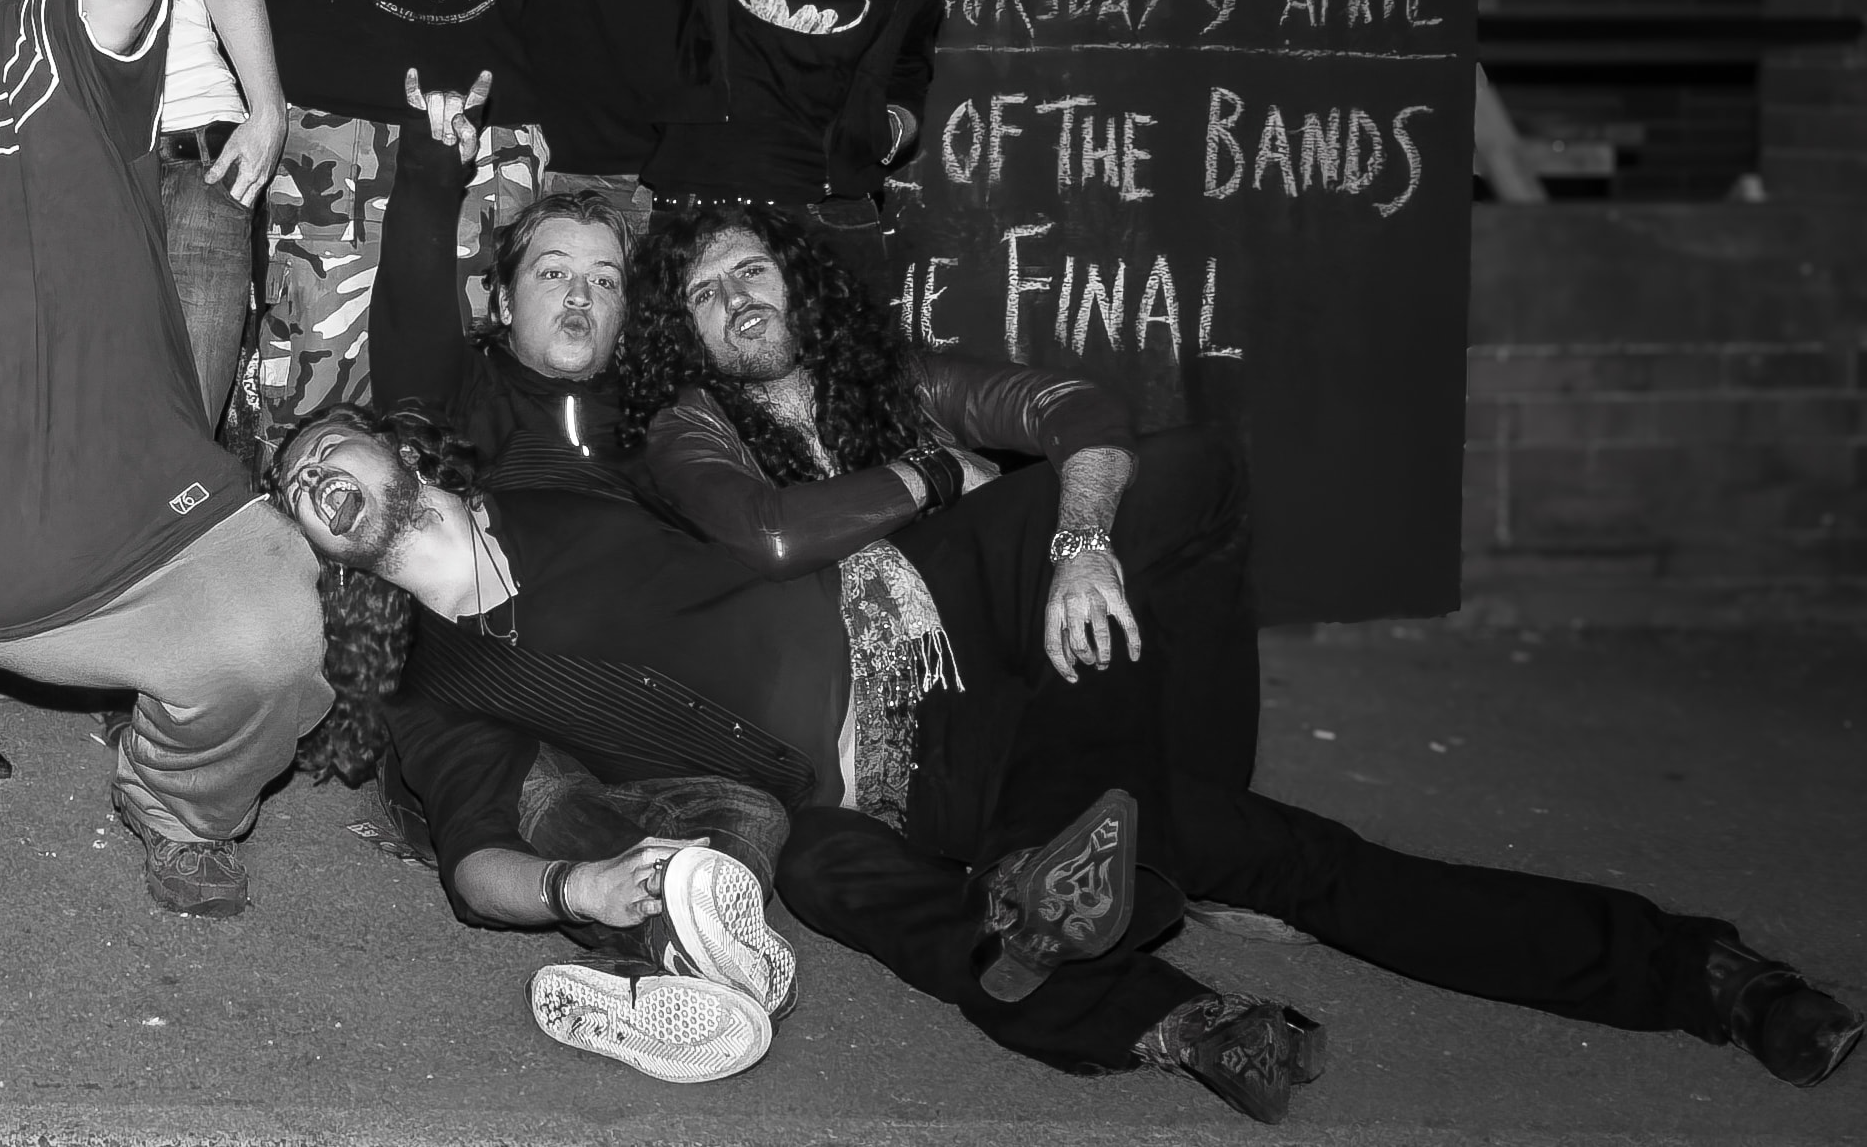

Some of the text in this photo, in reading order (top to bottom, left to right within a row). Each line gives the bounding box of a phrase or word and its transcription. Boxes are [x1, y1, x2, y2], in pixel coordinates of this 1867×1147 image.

[941, 86, 1434, 217] OF THE BANDS
[1000, 221, 1244, 364] FINAL
